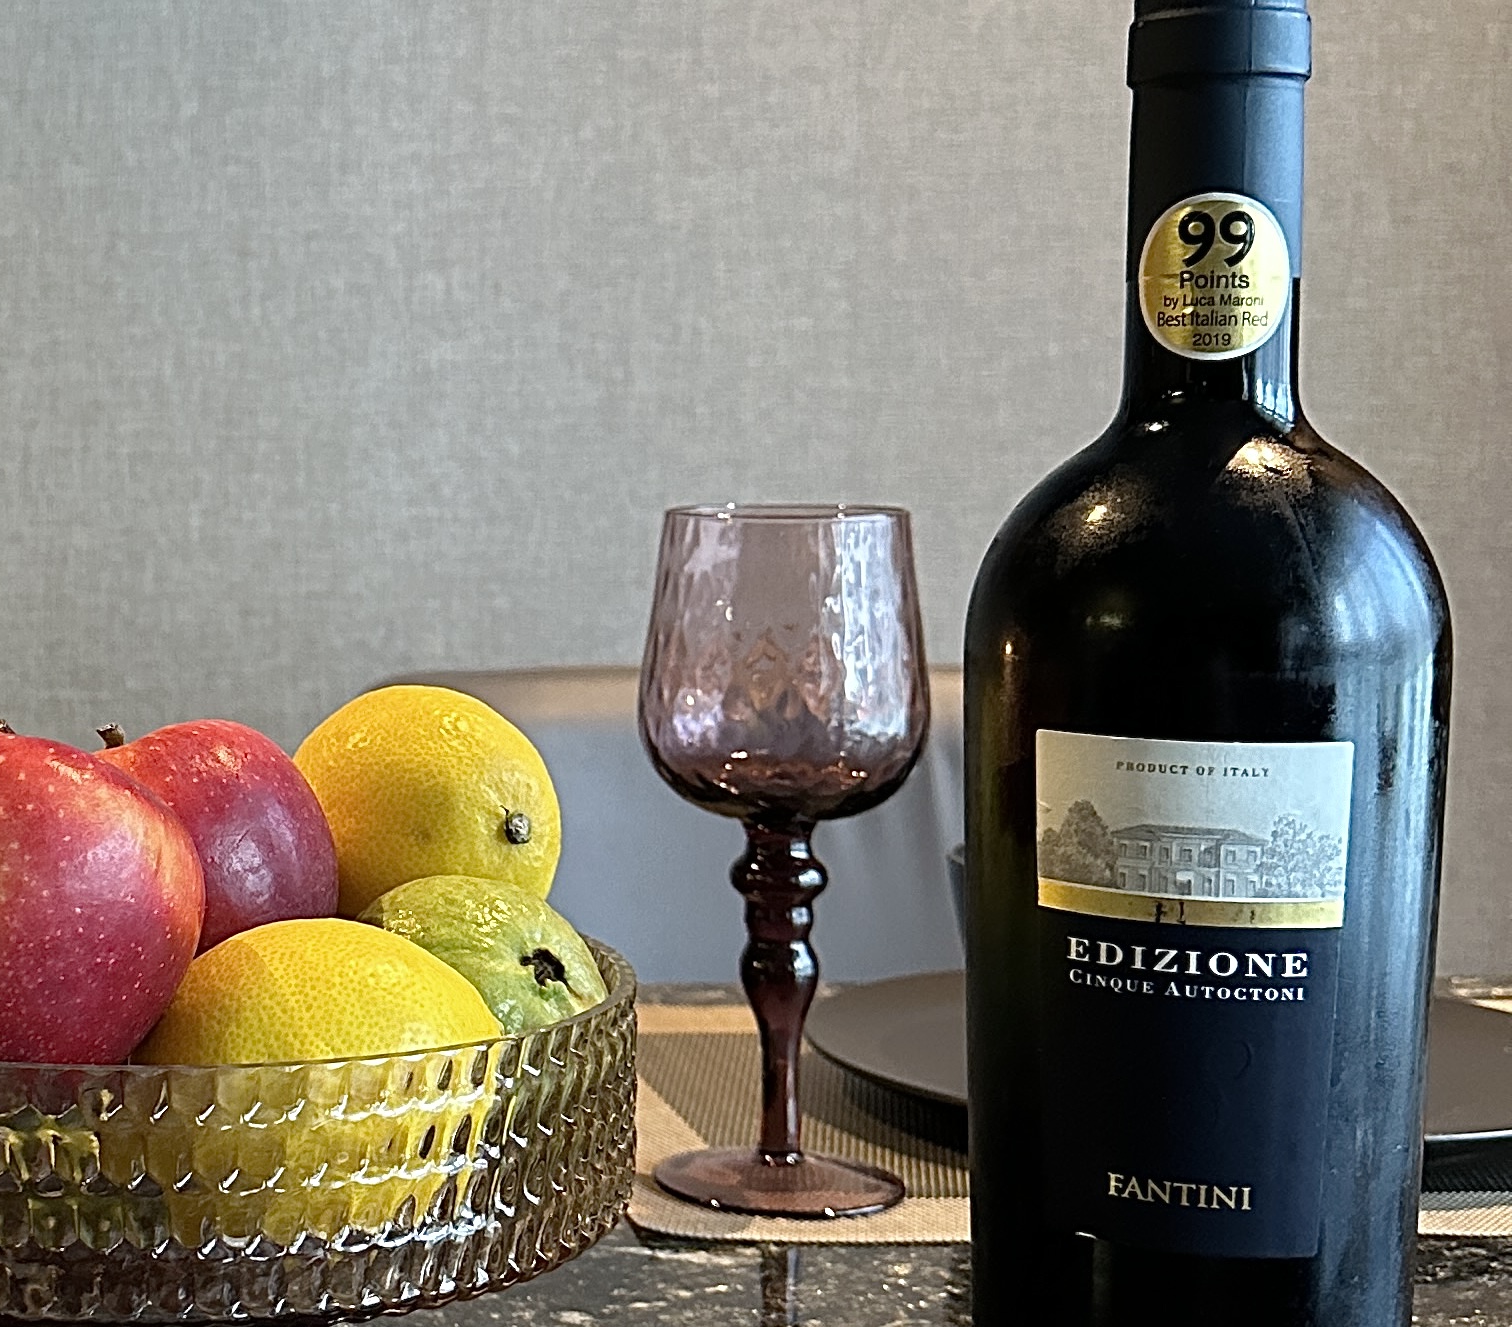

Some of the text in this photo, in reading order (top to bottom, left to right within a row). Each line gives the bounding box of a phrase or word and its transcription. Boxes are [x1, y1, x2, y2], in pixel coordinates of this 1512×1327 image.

[1178, 210, 1255, 267] 99
[1179, 271, 1250, 289] Points
[1163, 294, 1264, 310] by Luca Maroni
[1157, 311, 1269, 327] Best Italian Red
[1192, 333, 1231, 347] 2019
[1116, 761, 1270, 778] PRODUCT OF ITALY
[1066, 936, 1309, 978] EDIZIONE
[1108, 1172, 1251, 1210] FANTINI
